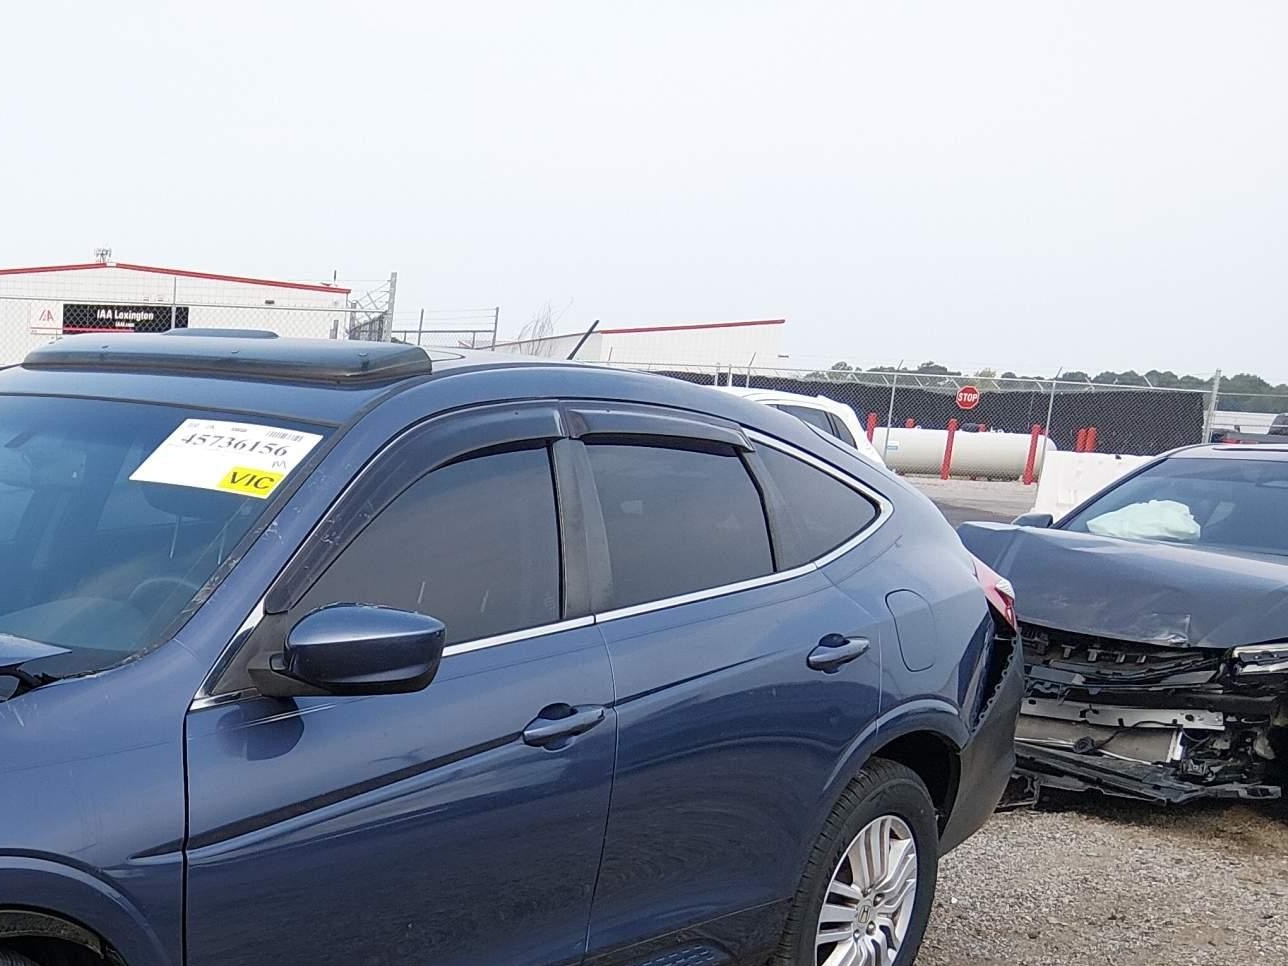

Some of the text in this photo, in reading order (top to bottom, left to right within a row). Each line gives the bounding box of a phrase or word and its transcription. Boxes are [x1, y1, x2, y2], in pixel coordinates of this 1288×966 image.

[97, 309, 113, 319] IAA
[957, 392, 977, 402] STOP
[180, 432, 292, 457] 45736156
[230, 471, 275, 489] VIC
